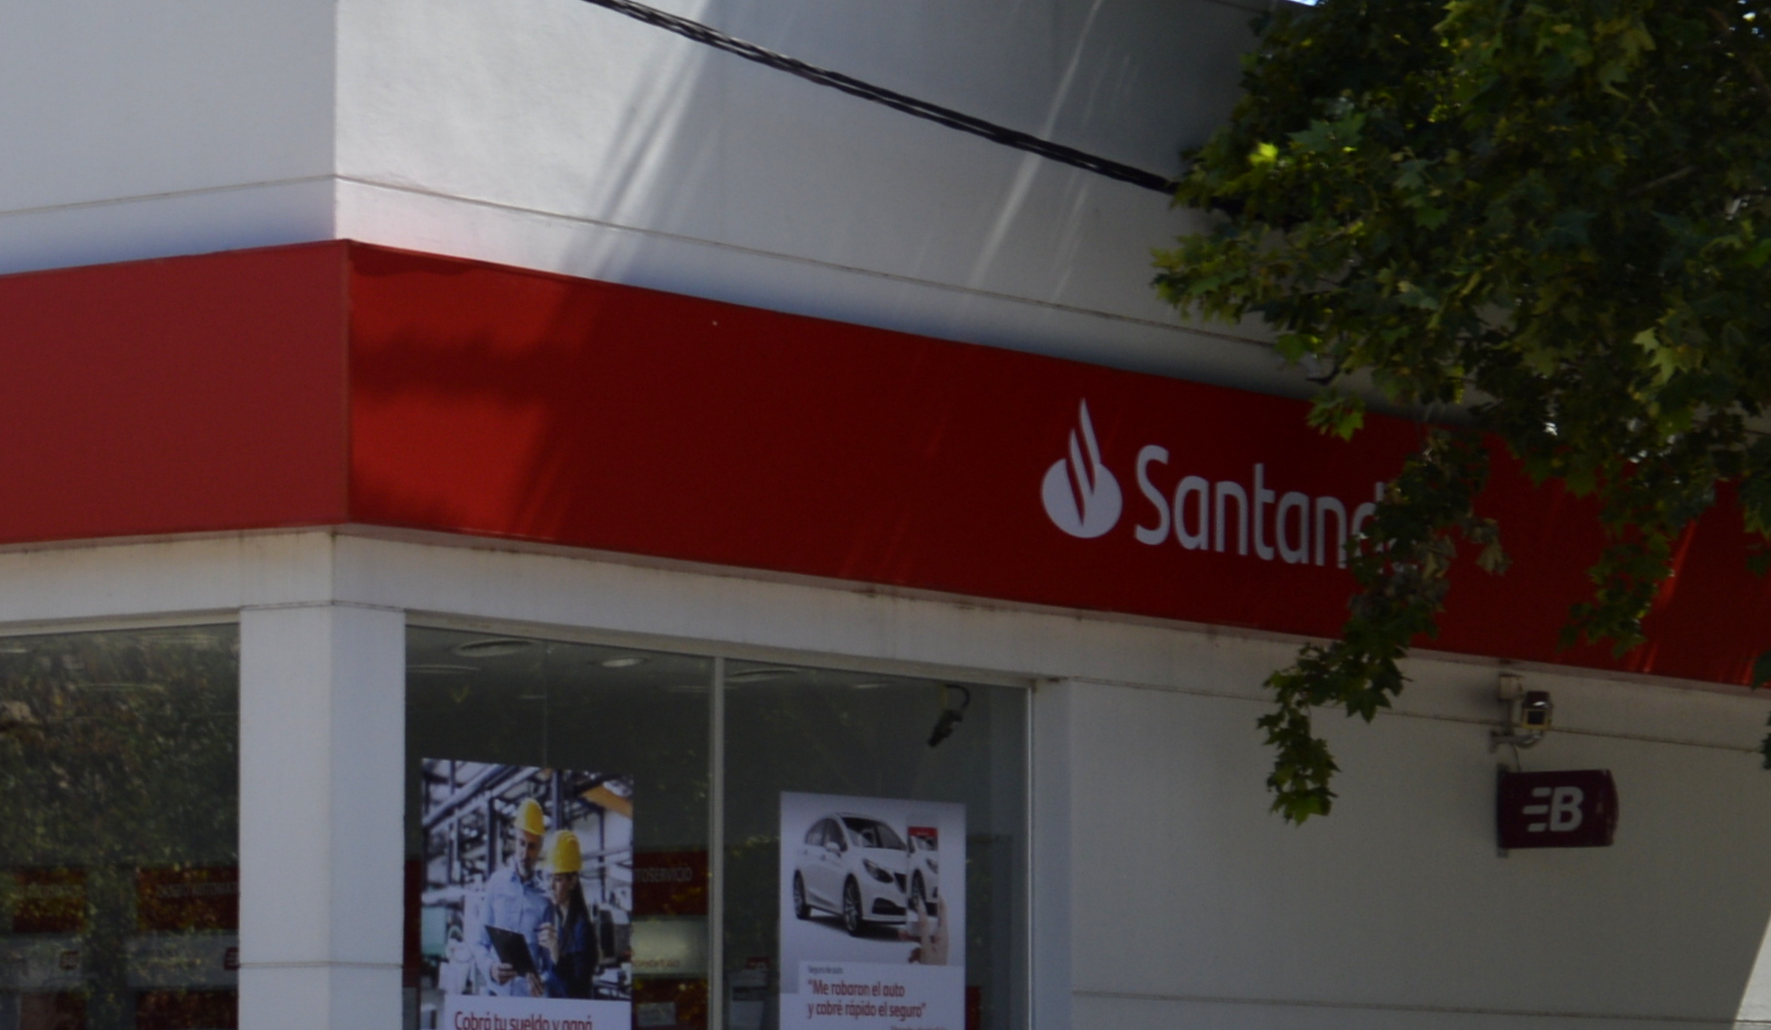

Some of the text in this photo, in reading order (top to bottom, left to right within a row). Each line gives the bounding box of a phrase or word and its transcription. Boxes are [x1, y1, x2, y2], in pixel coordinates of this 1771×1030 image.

[831, 981, 870, 996] robaron
[872, 981, 881, 996] el
[883, 983, 905, 997] auto
[807, 1005, 815, 1019] y
[817, 1001, 843, 1016] cobré
[845, 1001, 876, 1020] rápido
[879, 1002, 887, 1017] el
